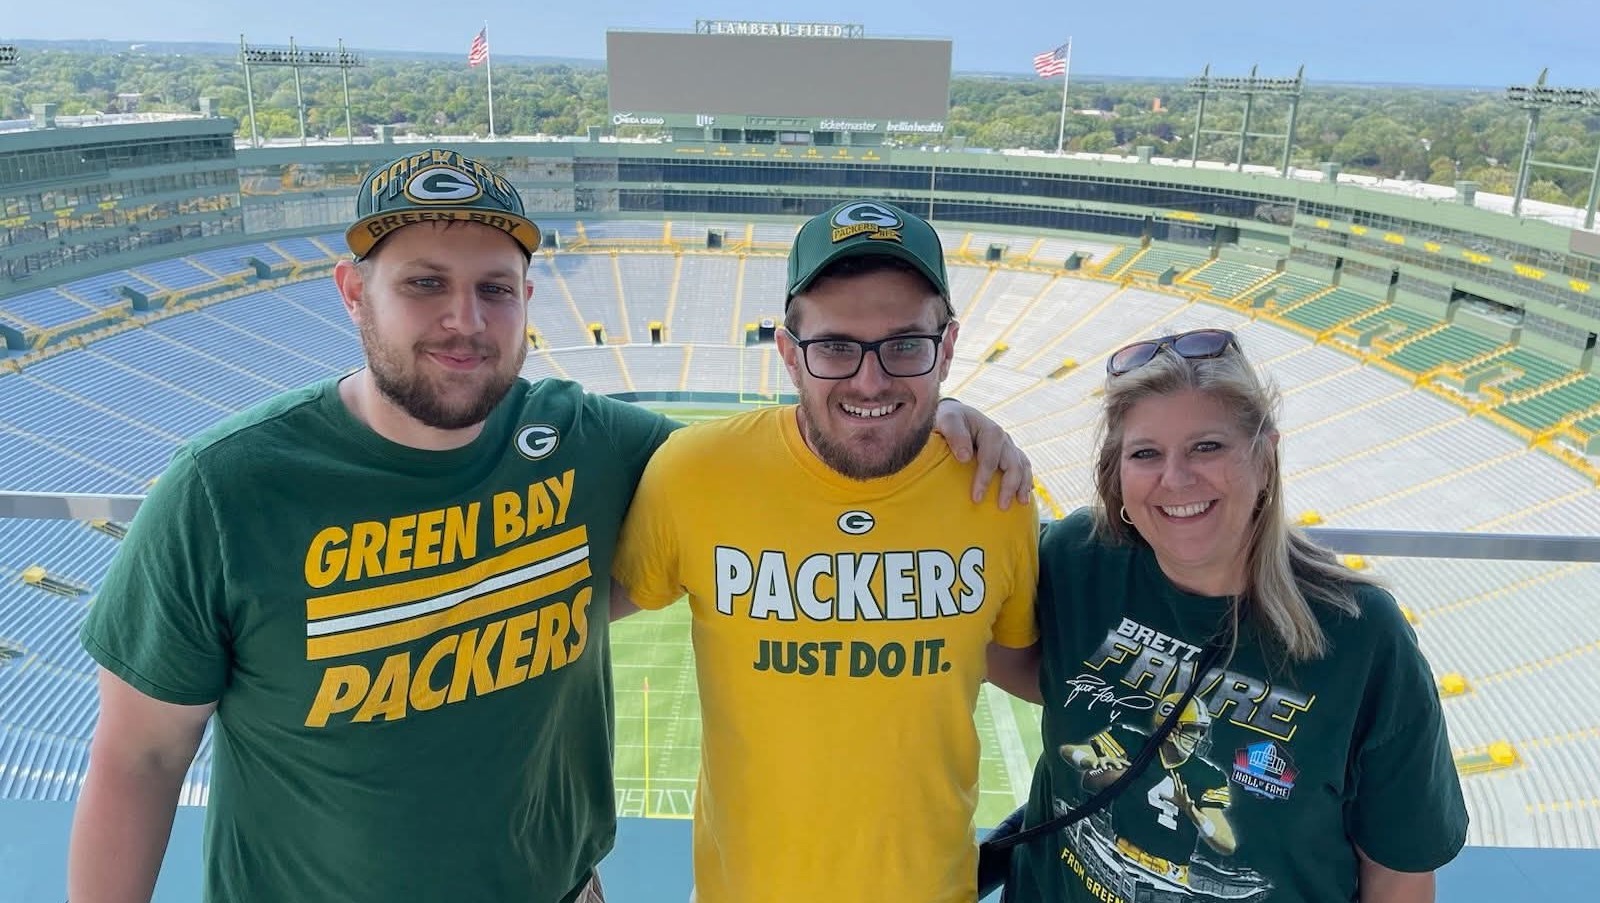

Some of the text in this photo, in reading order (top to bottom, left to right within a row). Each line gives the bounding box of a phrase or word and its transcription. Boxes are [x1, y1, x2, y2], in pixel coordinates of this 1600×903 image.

[717, 22, 842, 37] LAMBEAU FIELD
[819, 119, 877, 131] ticketmaster
[370, 148, 516, 214] PACKERS
[406, 165, 482, 202] G
[366, 211, 521, 239] GREEN BAY
[833, 202, 898, 227] G
[834, 223, 877, 239] PACKERS
[516, 426, 558, 458] G
[304, 468, 576, 589] GREEN BAY
[837, 510, 875, 535] G
[715, 546, 986, 621] PACKERS
[303, 586, 593, 728] PACKERS
[1116, 616, 1203, 663] BRETT
[753, 638, 952, 678] JUST DO IT.
[1082, 627, 1317, 742] FAVRE
[1235, 771, 1259, 788] HALL
[1265, 782, 1289, 797] FAME
[1147, 775, 1180, 831] 4
[1060, 847, 1086, 881] FROM
